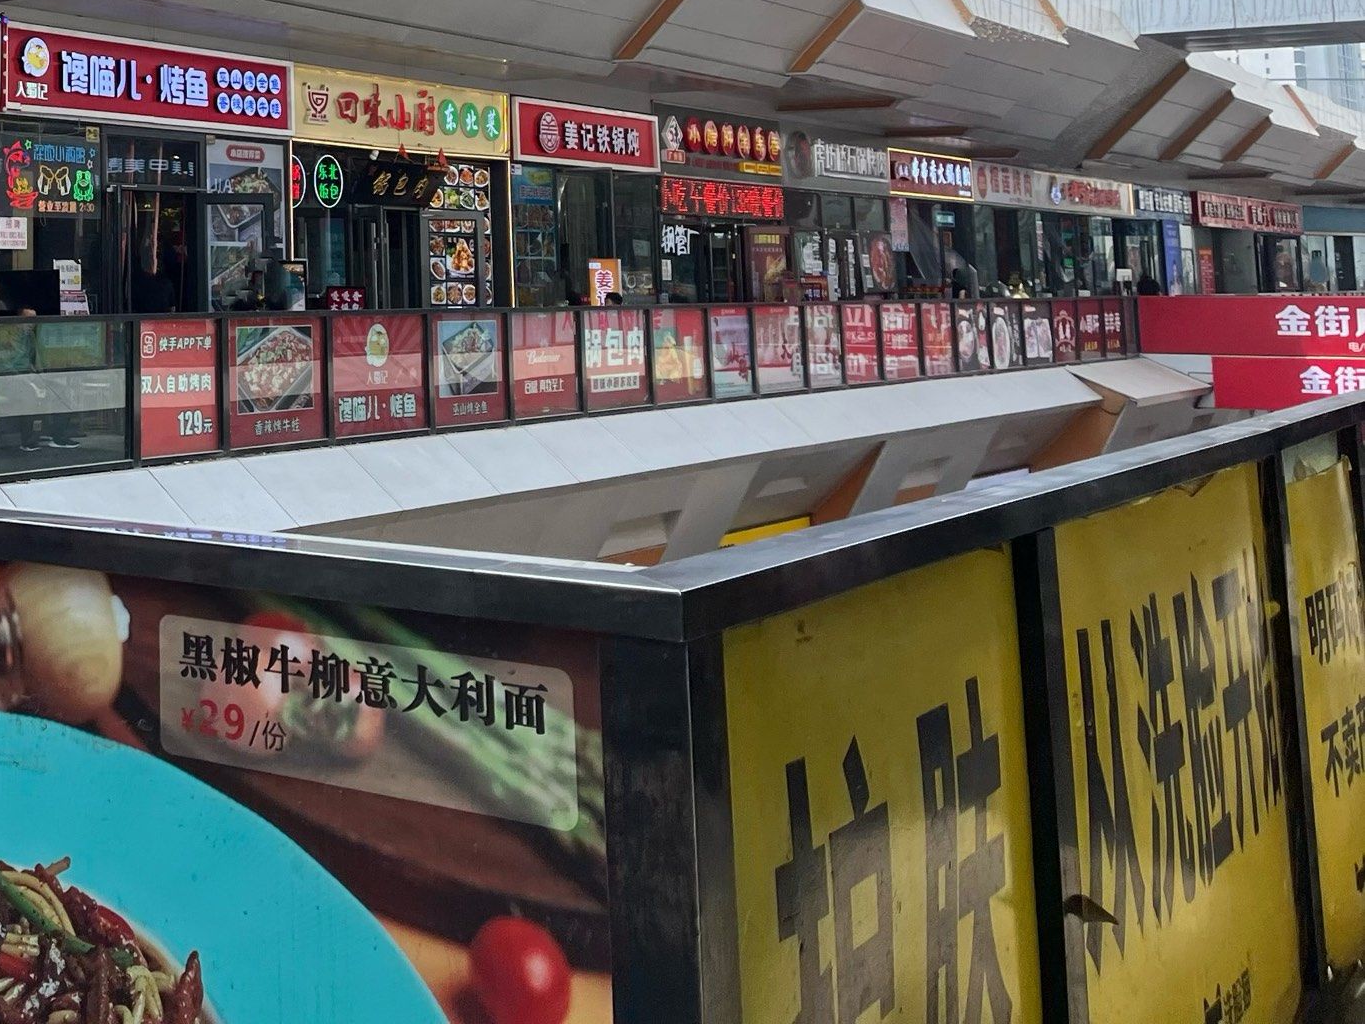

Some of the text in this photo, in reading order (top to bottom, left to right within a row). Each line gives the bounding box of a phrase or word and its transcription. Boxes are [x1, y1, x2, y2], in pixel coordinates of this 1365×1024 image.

[335, 82, 501, 138] 回味小厨 东北菜
[564, 120, 641, 158] 姜记铁锅炖
[318, 164, 339, 181] 东北
[319, 183, 339, 200] 饭包
[1275, 304, 1365, 337] 金街
[158, 335, 212, 352] 快手APP下单
[141, 373, 212, 394] 双人自助烤肉
[177, 411, 213, 437] 129元
[178, 631, 550, 736] 黑椒牛柳意大利面
